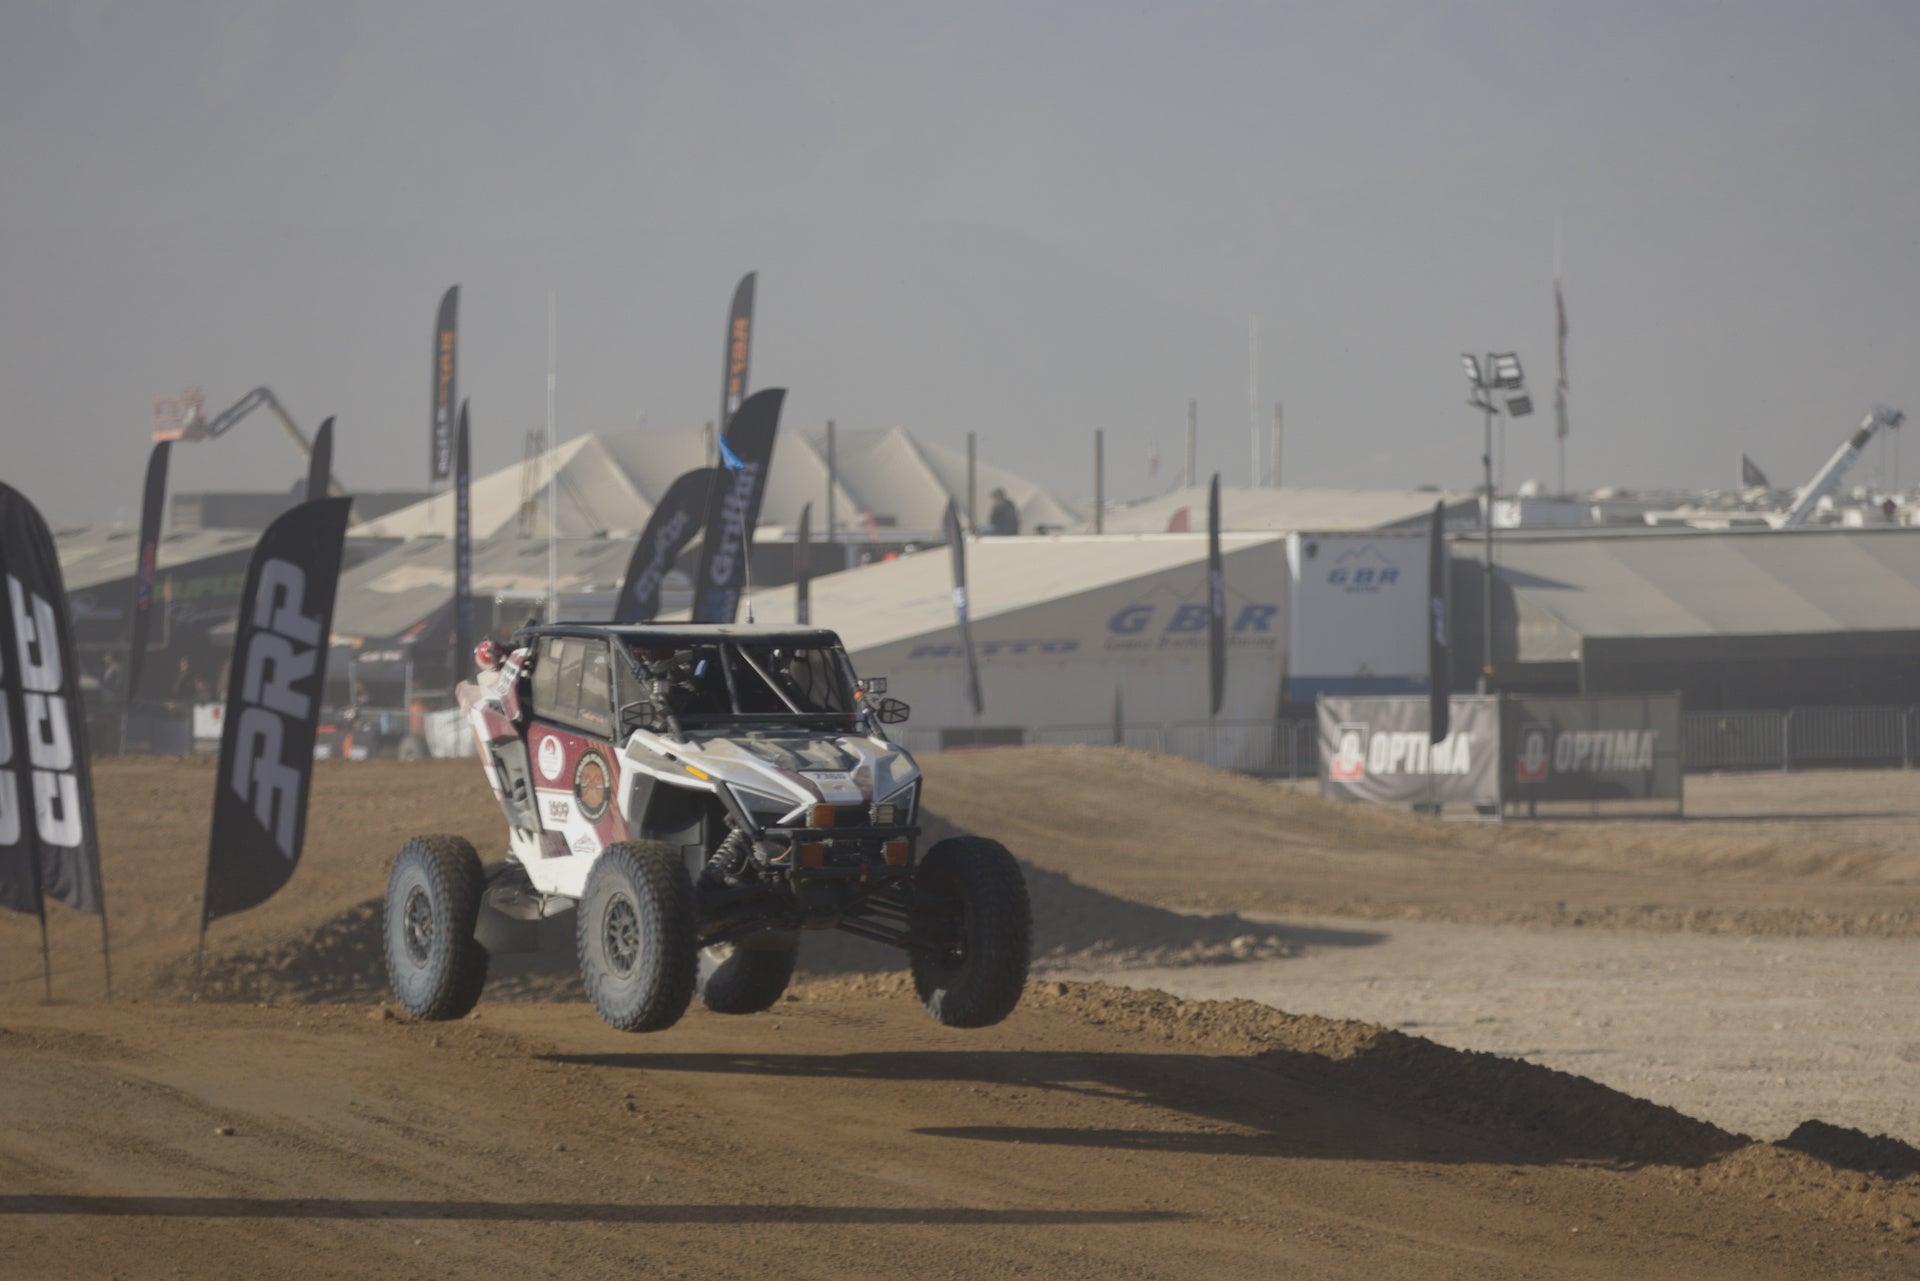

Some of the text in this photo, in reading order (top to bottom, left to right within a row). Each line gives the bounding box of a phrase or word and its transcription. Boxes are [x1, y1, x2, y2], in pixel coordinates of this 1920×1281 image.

[232, 557, 322, 860] PRP
[1368, 730, 1471, 775] OPTIMA
[1553, 731, 1654, 773] OPTIMA
